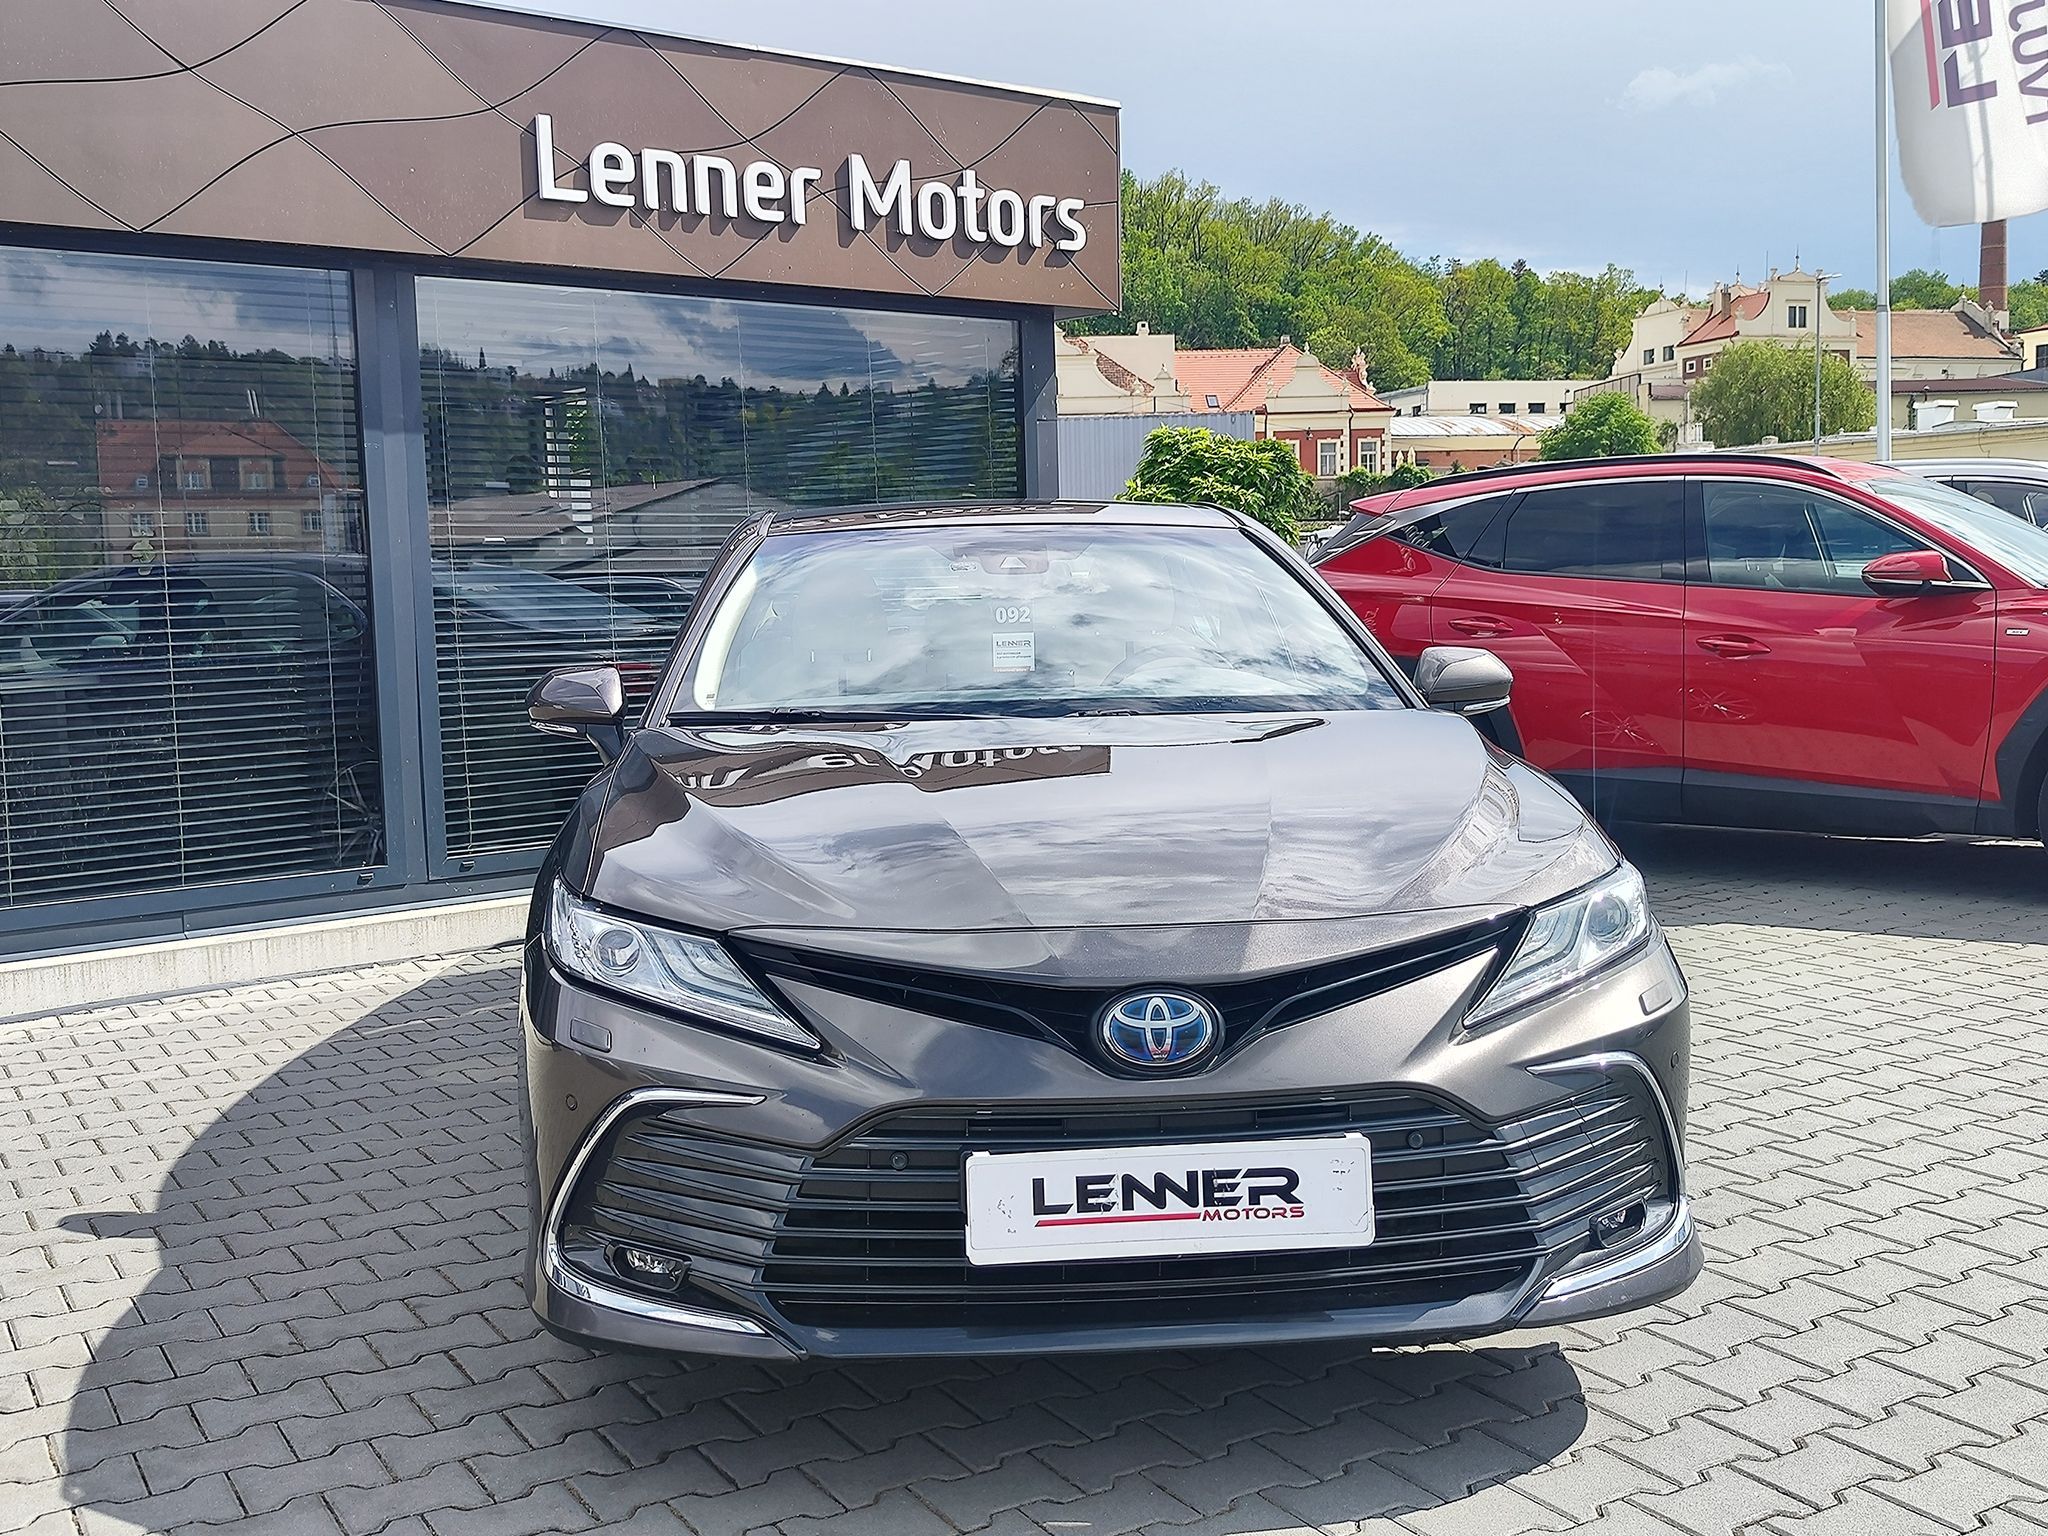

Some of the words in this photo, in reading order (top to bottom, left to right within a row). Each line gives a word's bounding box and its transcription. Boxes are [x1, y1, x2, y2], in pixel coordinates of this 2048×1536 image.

[534, 112, 822, 226] Lenner
[847, 152, 1088, 252] Motors
[995, 606, 1031, 624] 092
[1031, 1166, 1304, 1216] LENNER
[1201, 1204, 1305, 1223] MOTORS
